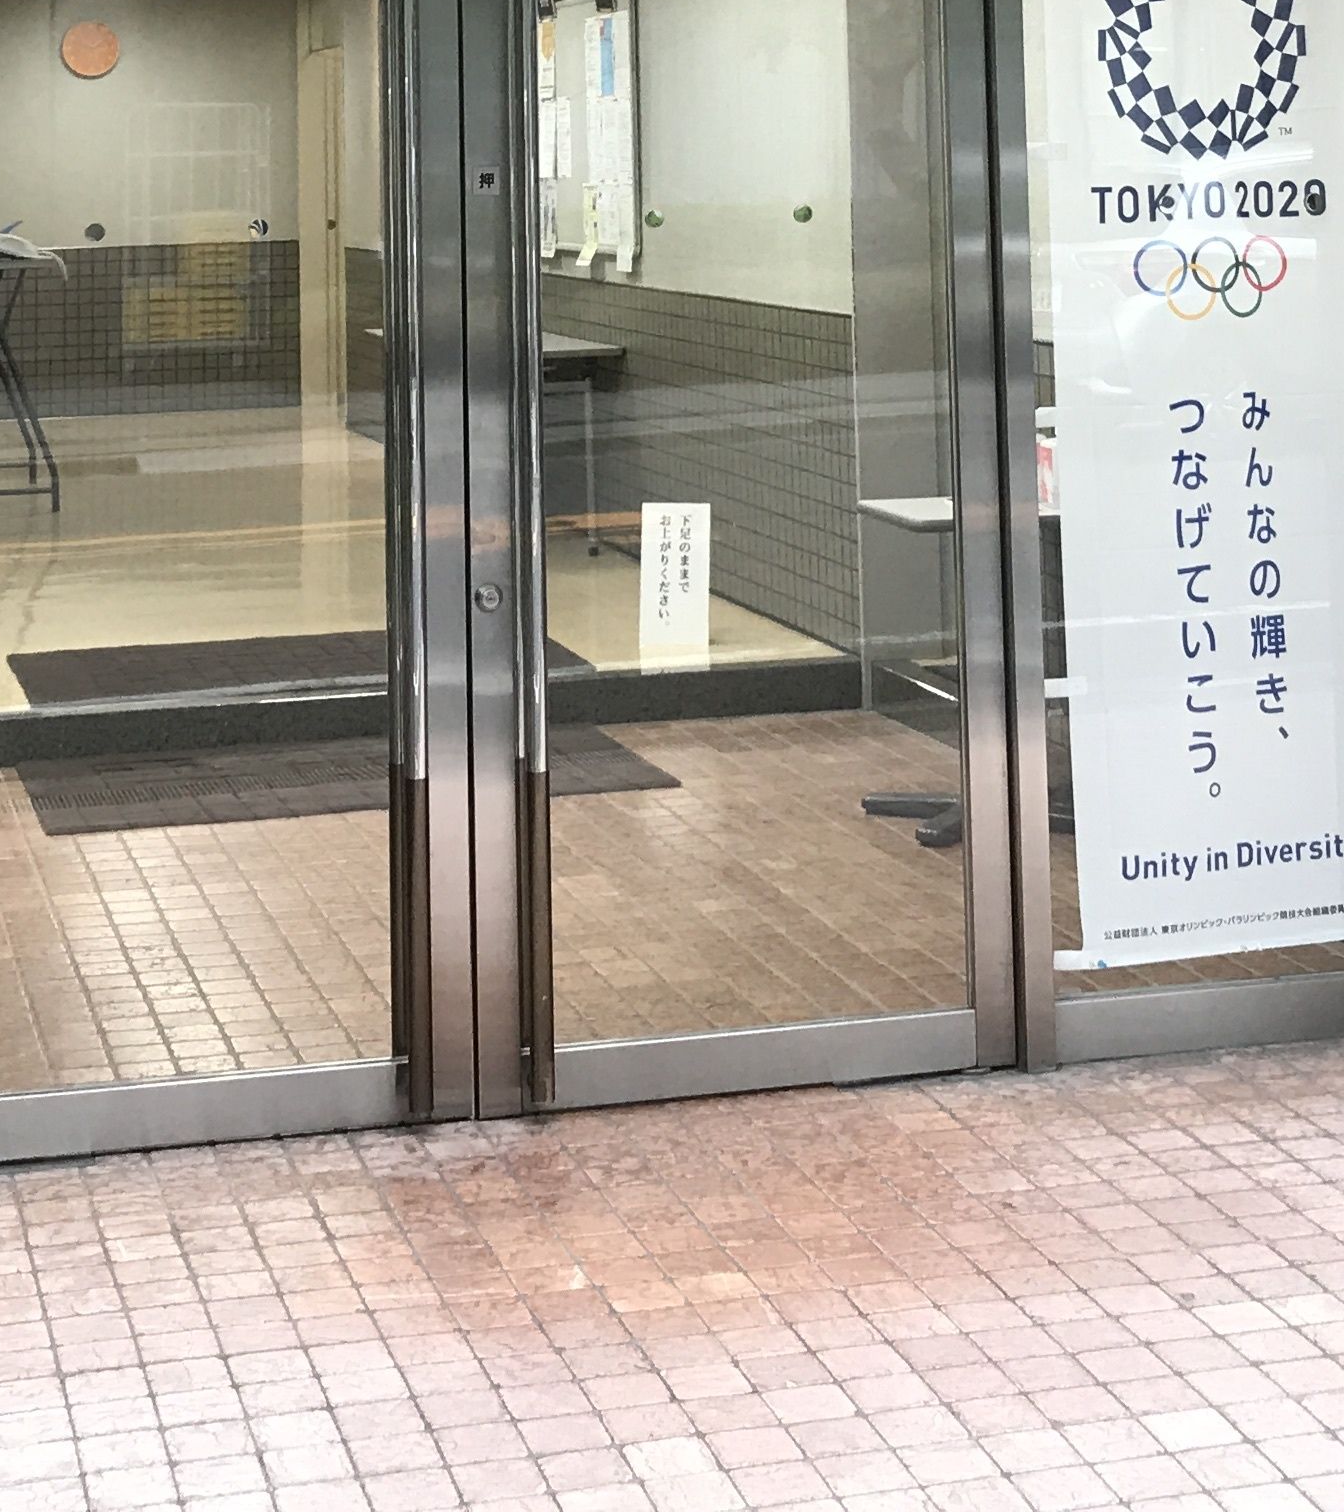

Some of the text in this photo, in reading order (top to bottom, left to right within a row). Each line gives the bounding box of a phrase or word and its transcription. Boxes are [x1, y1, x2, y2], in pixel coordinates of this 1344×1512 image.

[479, 172, 495, 189] 押
[1091, 179, 1327, 224] TOKYO 2020
[679, 514, 692, 593] 下足のままで
[1241, 391, 1289, 739] みんなの輝き、
[1169, 398, 1222, 799] つなげていこう。
[1122, 852, 1198, 881] Unity
[1207, 847, 1228, 872] in
